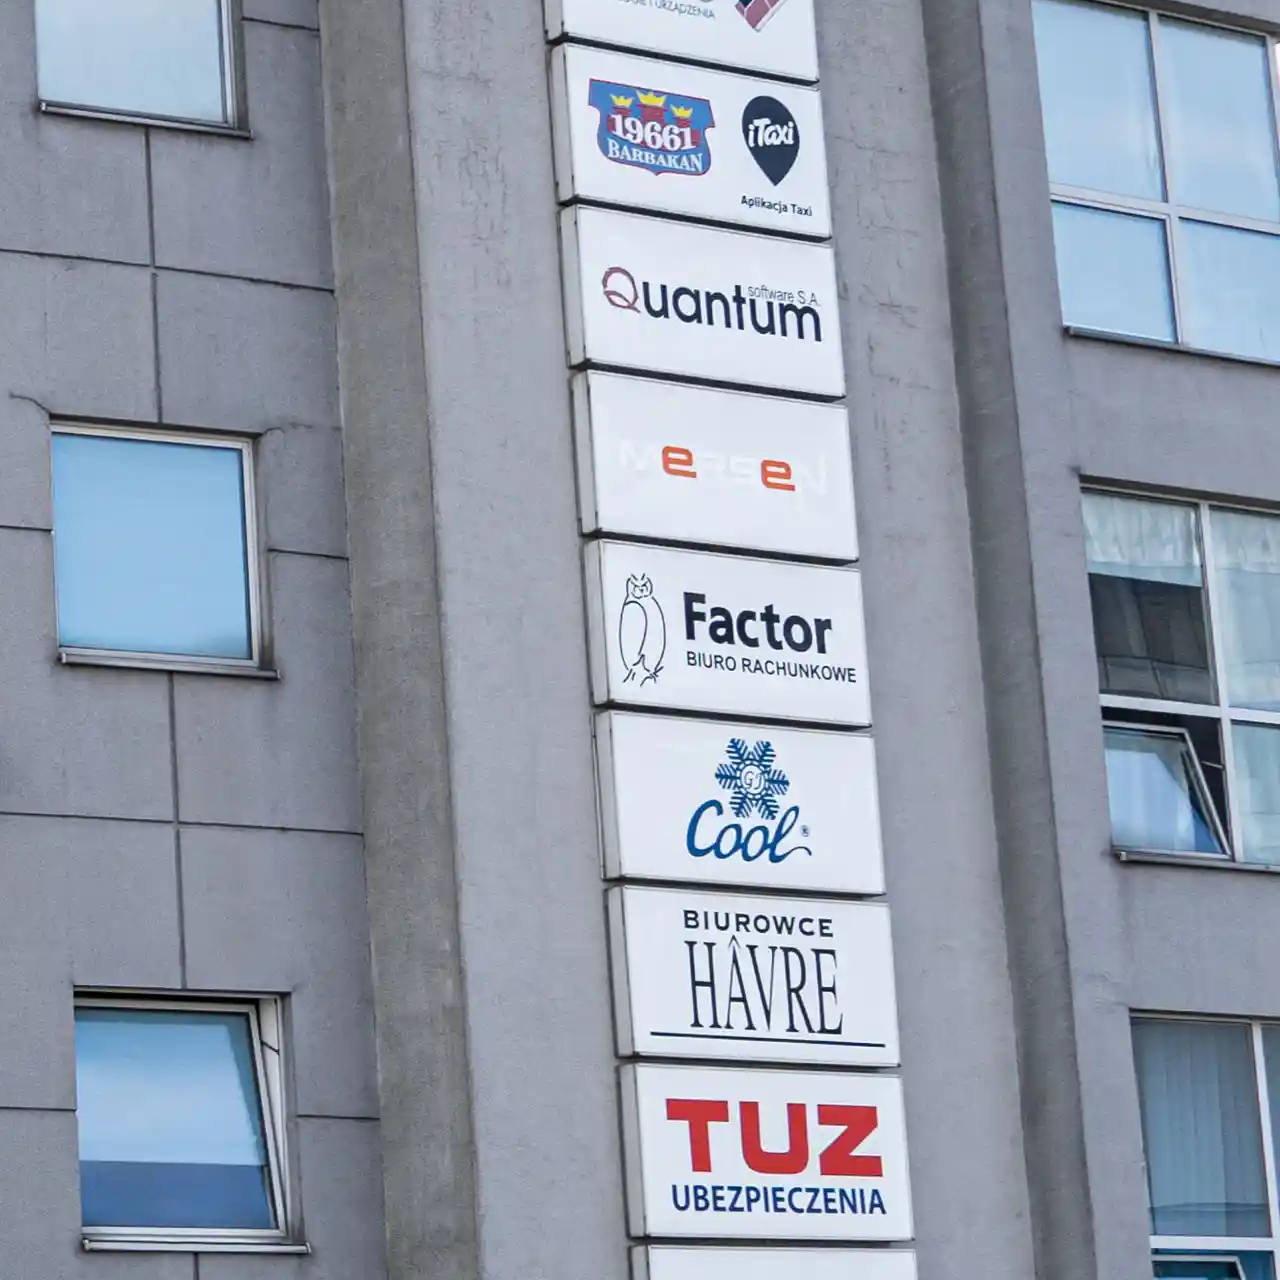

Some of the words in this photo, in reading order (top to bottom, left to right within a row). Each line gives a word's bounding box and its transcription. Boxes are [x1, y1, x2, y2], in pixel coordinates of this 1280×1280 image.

[611, 114, 697, 152] 19661
[748, 118, 795, 148] iTaxi
[607, 137, 703, 172] BARBAKAN
[741, 195, 788, 214] Aplikacja
[790, 203, 813, 216] Taxi
[602, 266, 822, 342] Quantum
[747, 285, 794, 302] software
[683, 591, 833, 654] Factor
[686, 651, 737, 672] BIURO
[741, 657, 857, 684] RACHUNKOWE
[686, 799, 812, 863] Cool
[683, 909, 834, 938] BIUROWCE
[684, 934, 843, 1035] HÂVRE
[665, 1098, 884, 1177] TUZ
[671, 1184, 887, 1215] UBEZPIECZENIA
